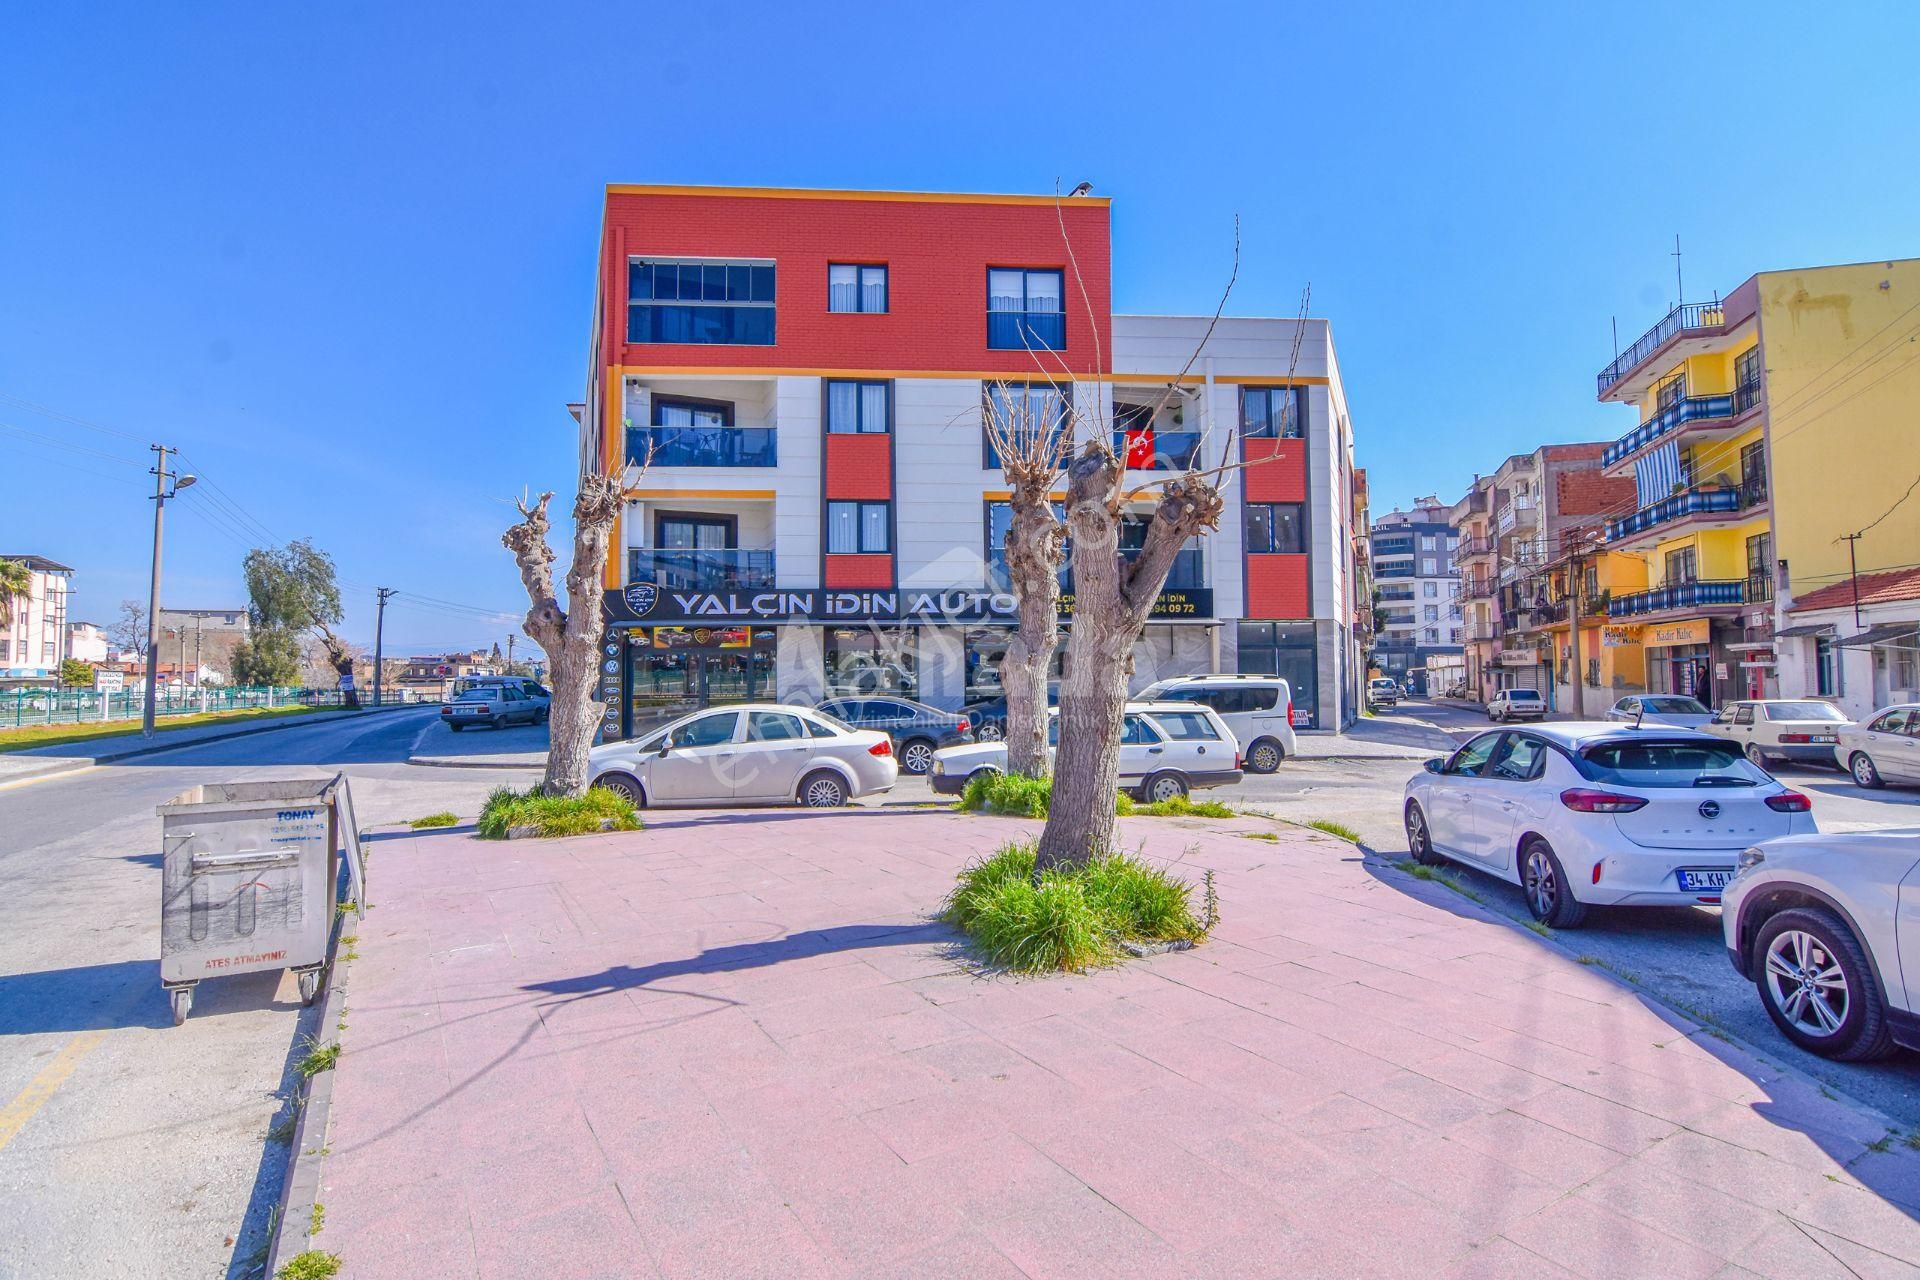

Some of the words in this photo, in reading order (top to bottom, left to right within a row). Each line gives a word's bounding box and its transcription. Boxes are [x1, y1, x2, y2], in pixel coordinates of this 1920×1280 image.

[673, 593, 813, 618] YALÇIN
[910, 593, 1018, 614] AUTO
[1056, 595, 1076, 604] LÇIN
[1168, 604, 1181, 613] 09
[1183, 604, 1195, 613] 72
[276, 809, 316, 822] TONAY
[1686, 872, 1704, 887] 34
